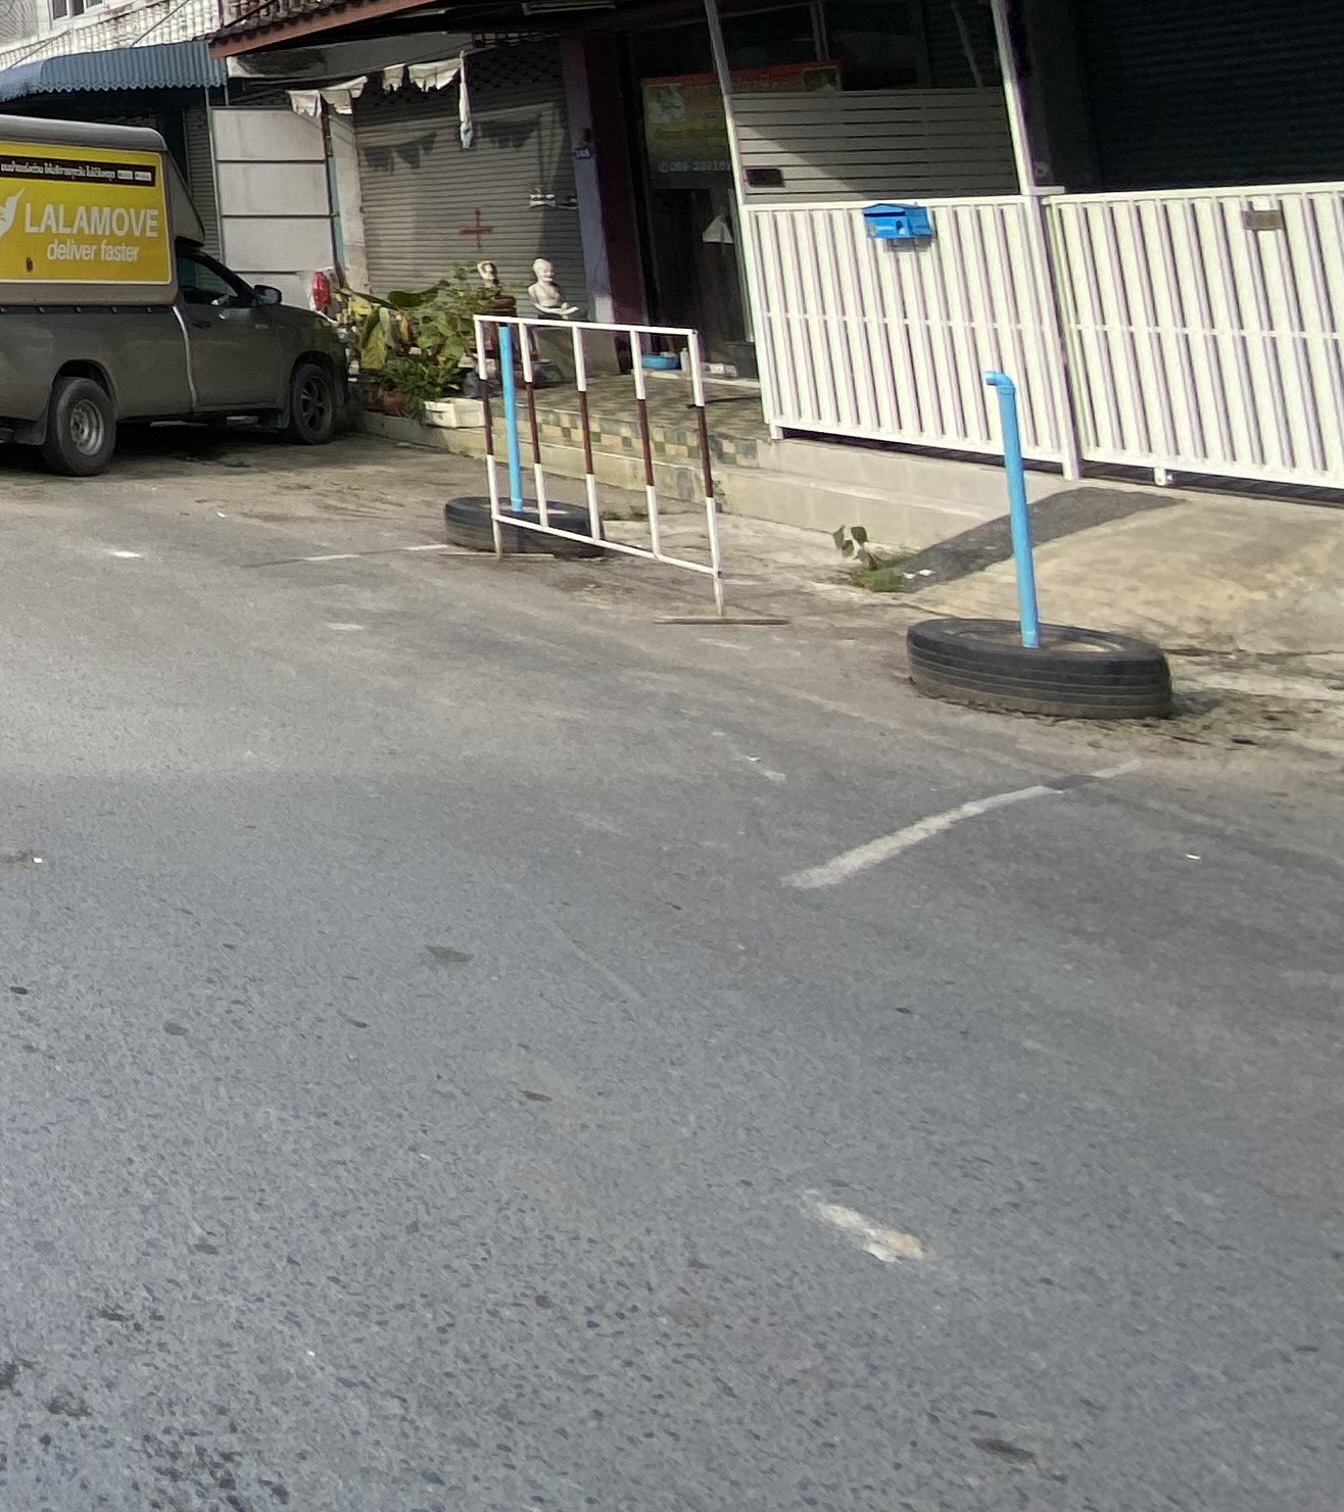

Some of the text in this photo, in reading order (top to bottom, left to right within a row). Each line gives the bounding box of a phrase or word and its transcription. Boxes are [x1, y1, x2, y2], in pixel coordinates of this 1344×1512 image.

[24, 203, 159, 238] LALAMOVE
[47, 239, 140, 262] deliver faster
